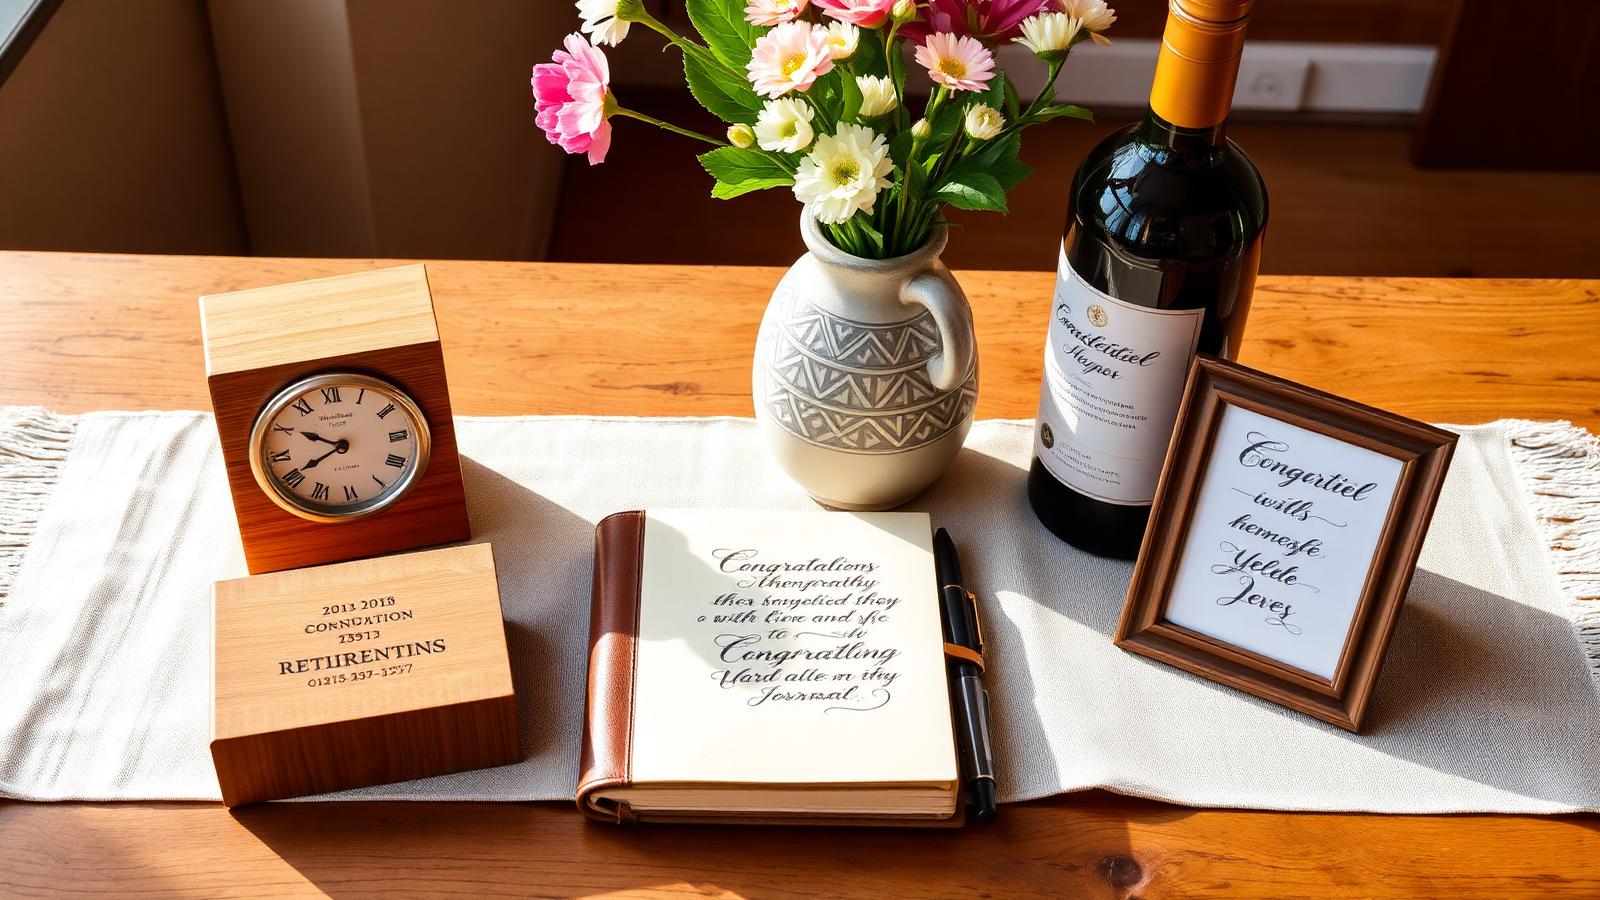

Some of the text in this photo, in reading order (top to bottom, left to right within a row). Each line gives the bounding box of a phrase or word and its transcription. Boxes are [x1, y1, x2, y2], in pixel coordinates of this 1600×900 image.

[320, 387, 342, 405] XII
[355, 388, 365, 405] I
[292, 398, 314, 416] XI
[273, 423, 294, 436] X
